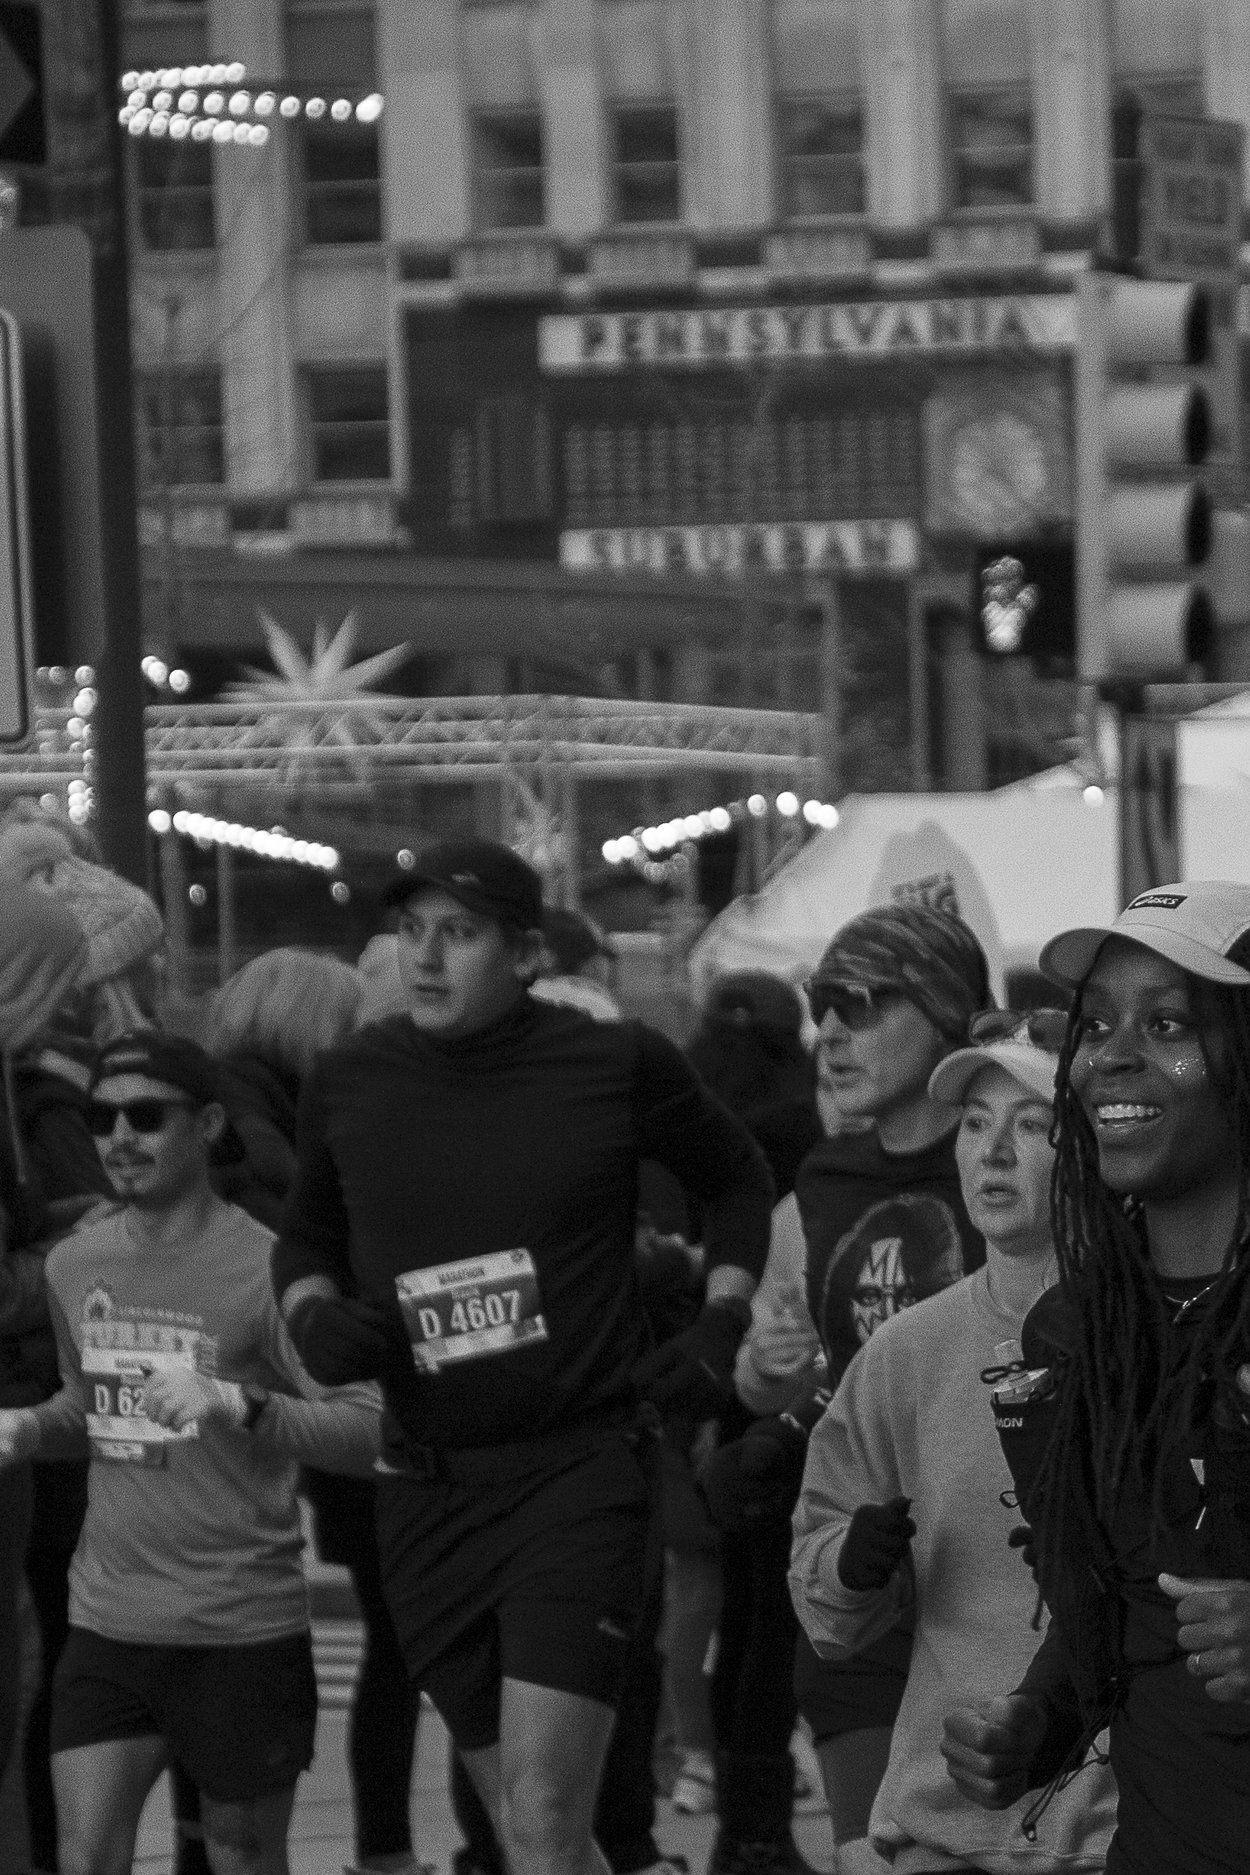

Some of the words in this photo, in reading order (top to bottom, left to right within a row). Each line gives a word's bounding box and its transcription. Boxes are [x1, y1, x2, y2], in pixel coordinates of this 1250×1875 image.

[583, 303, 1031, 363] PENNSYLVANIA
[587, 525, 891, 572] SUBURBAN
[418, 1308, 442, 1339] D
[451, 1290, 521, 1331] 4607
[95, 1384, 110, 1414] D
[117, 1386, 146, 1416] 62
